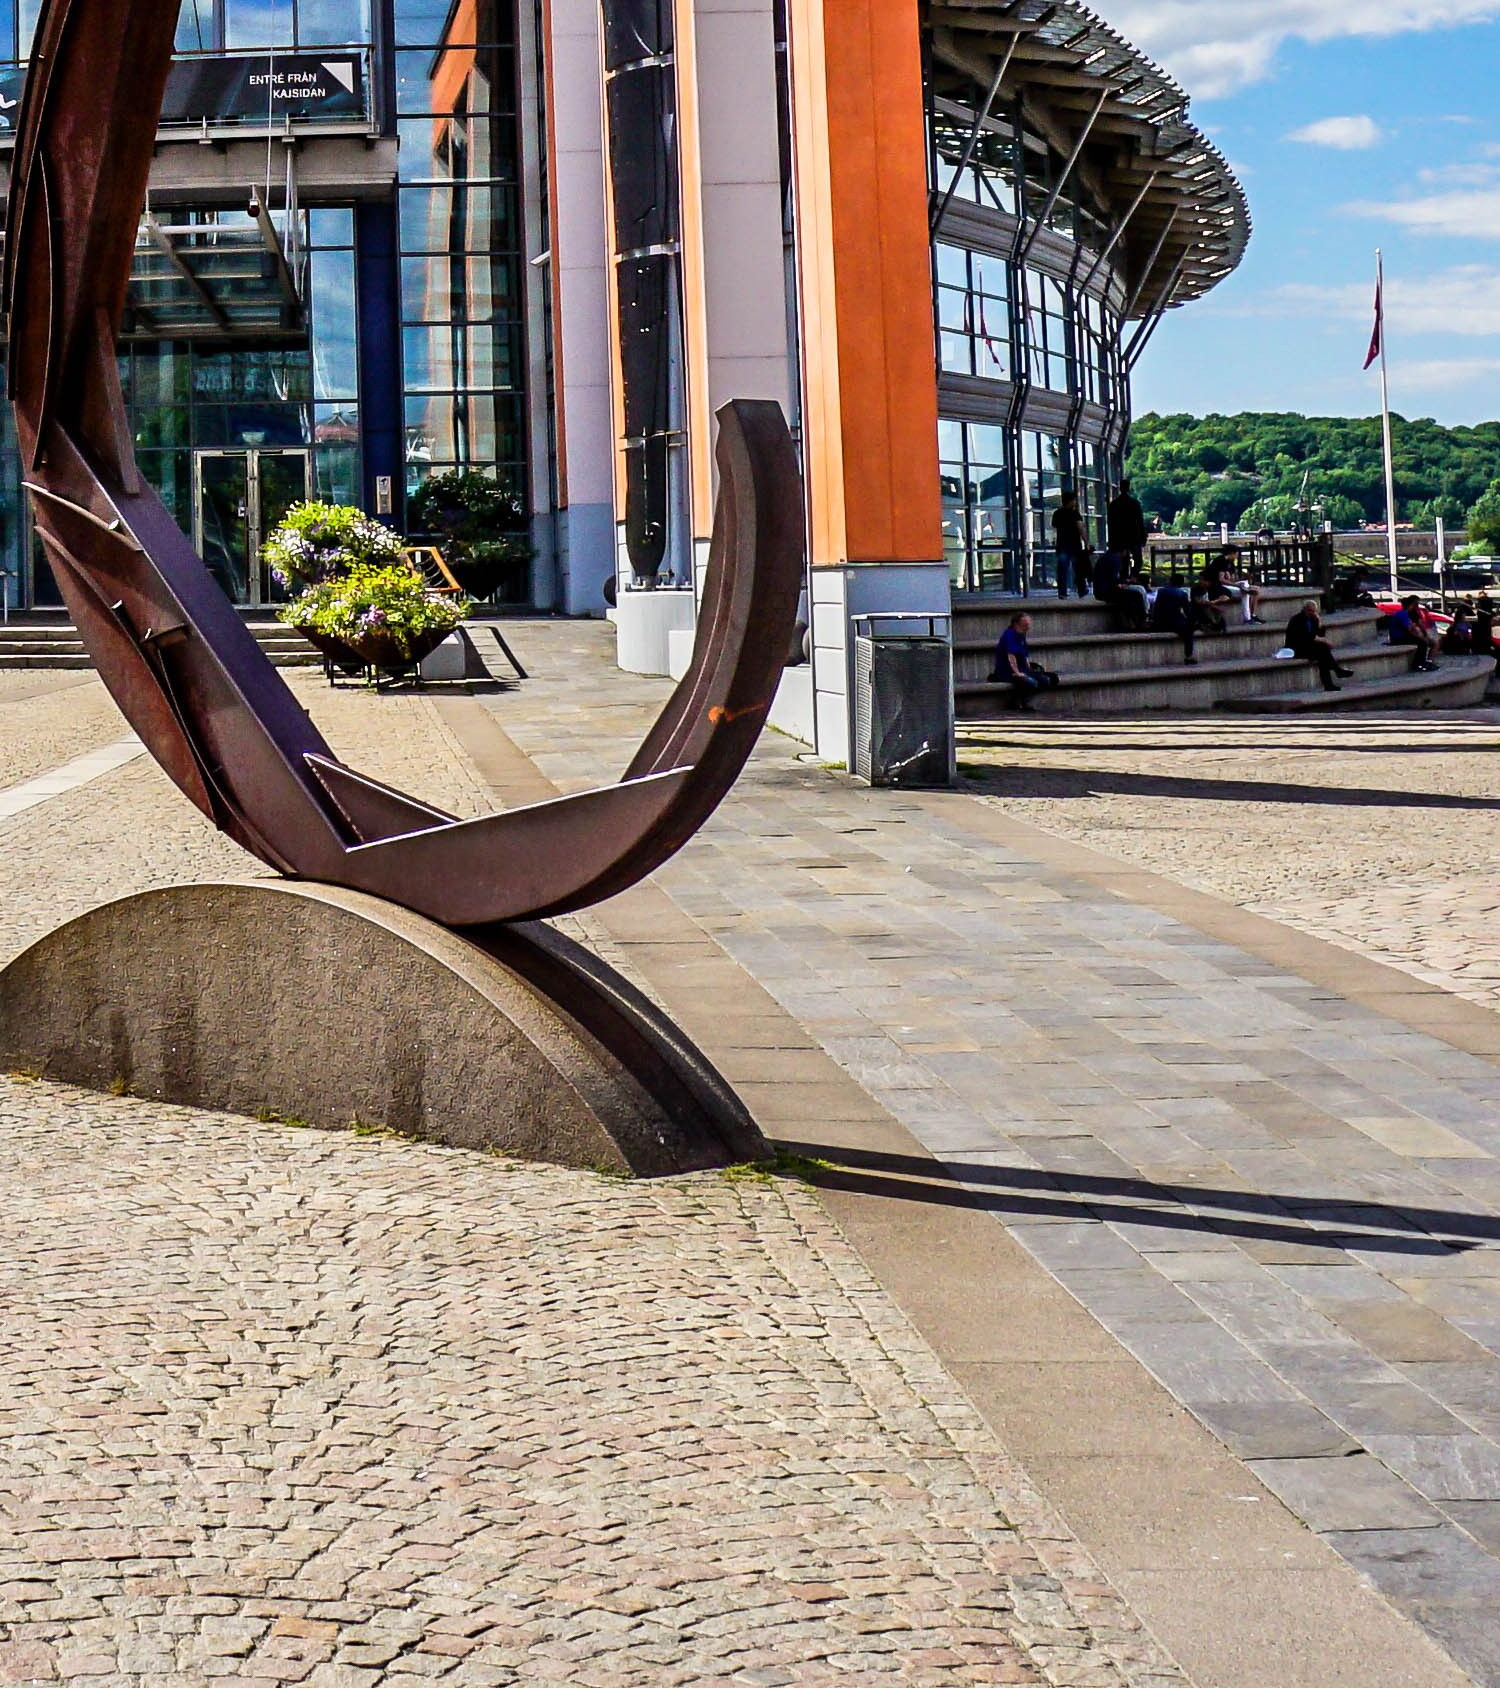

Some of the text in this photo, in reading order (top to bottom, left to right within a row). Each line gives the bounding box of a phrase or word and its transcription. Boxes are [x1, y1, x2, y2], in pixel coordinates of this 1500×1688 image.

[249, 72, 317, 85] ENTRÉ FRÅN
[272, 88, 326, 99] KAJSIDAN
